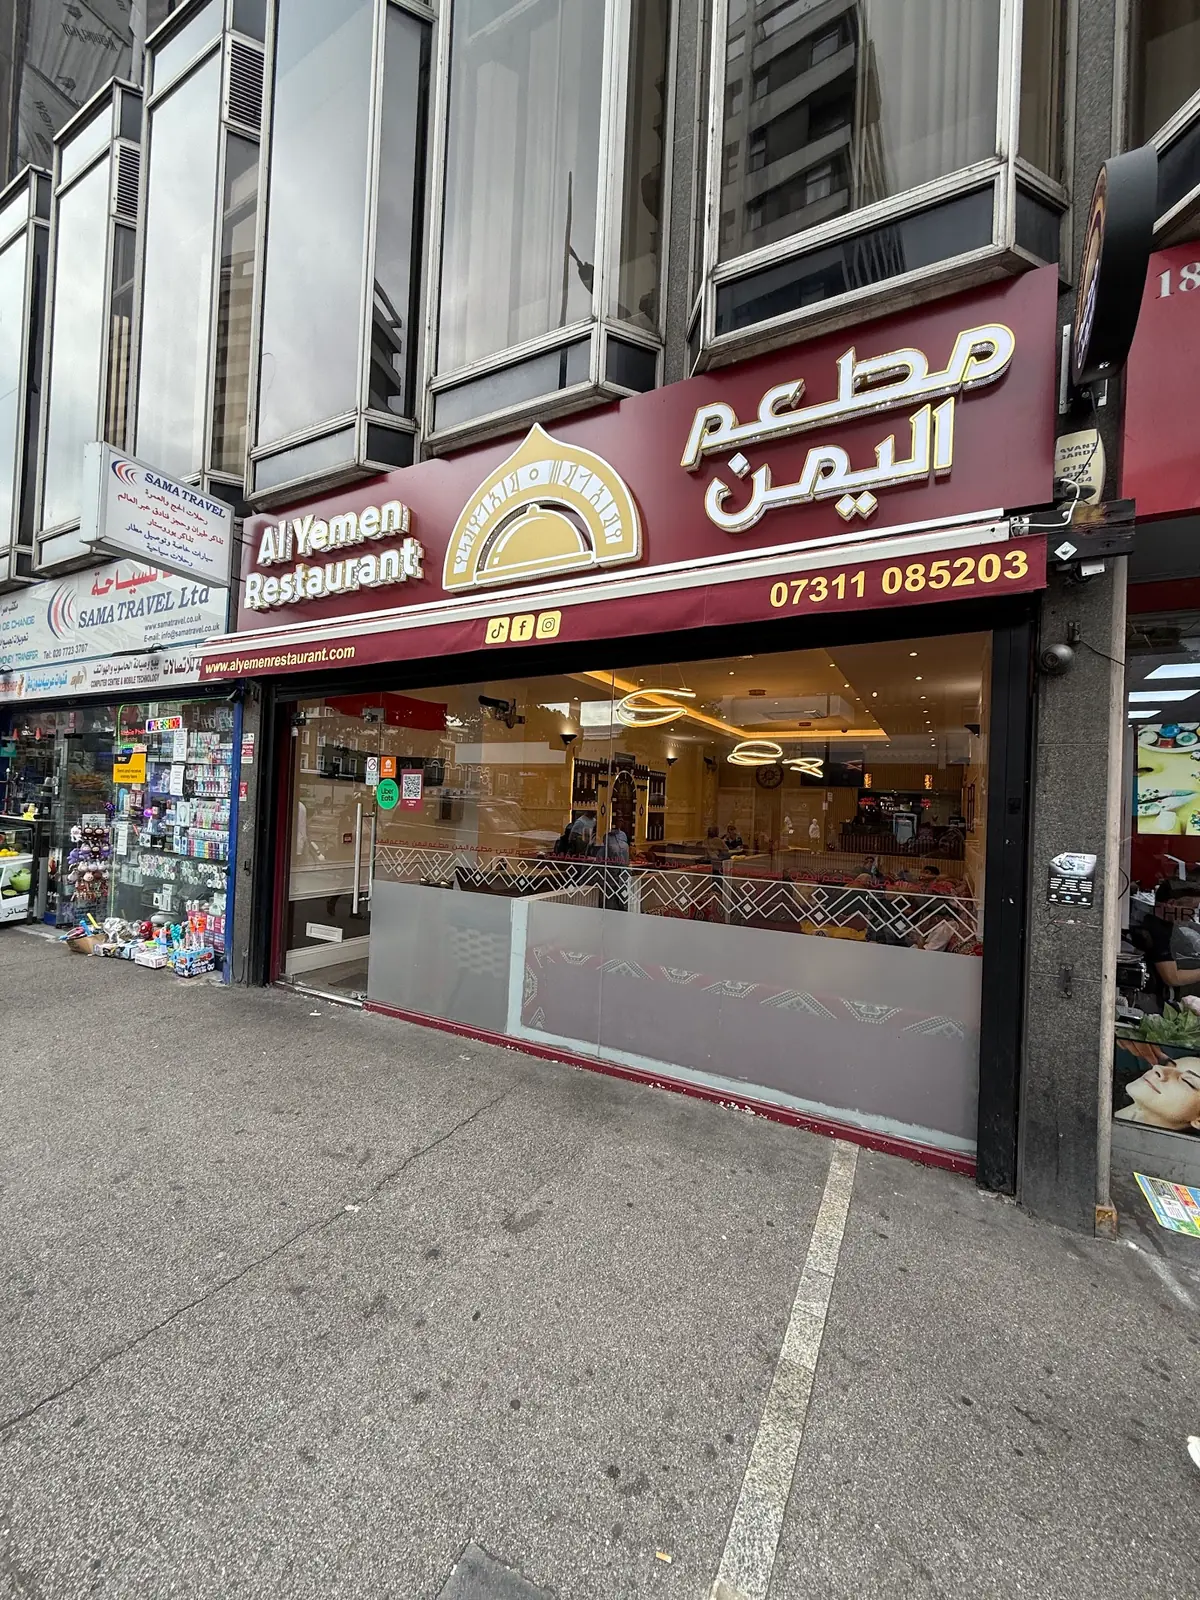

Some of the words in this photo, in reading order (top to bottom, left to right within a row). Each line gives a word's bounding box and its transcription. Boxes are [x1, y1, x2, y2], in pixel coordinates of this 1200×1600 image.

[680, 322, 1016, 472] مطعم
[704, 396, 956, 533] اليمن
[144, 472, 180, 497] SAMA
[181, 489, 226, 519] TRAVEL
[256, 519, 294, 567] Al
[292, 499, 411, 557] Yemen
[243, 537, 423, 614] Restaurant
[770, 570, 866, 608] 07311
[881, 550, 1029, 595] 085203
[11, 615, 36, 629] CHANGE
[78, 604, 115, 629] SAMA
[116, 591, 175, 622] TRAVEL
[177, 585, 211, 610] Ltd
[144, 614, 202, 631] www.samatravel.co.uk
[160, 622, 220, 640] info@samatravel.co.uk
[43, 650, 52, 660] Tel:
[205, 645, 356, 675] www.alyemenrestaurant.com
[381, 787, 394, 795] Uber
